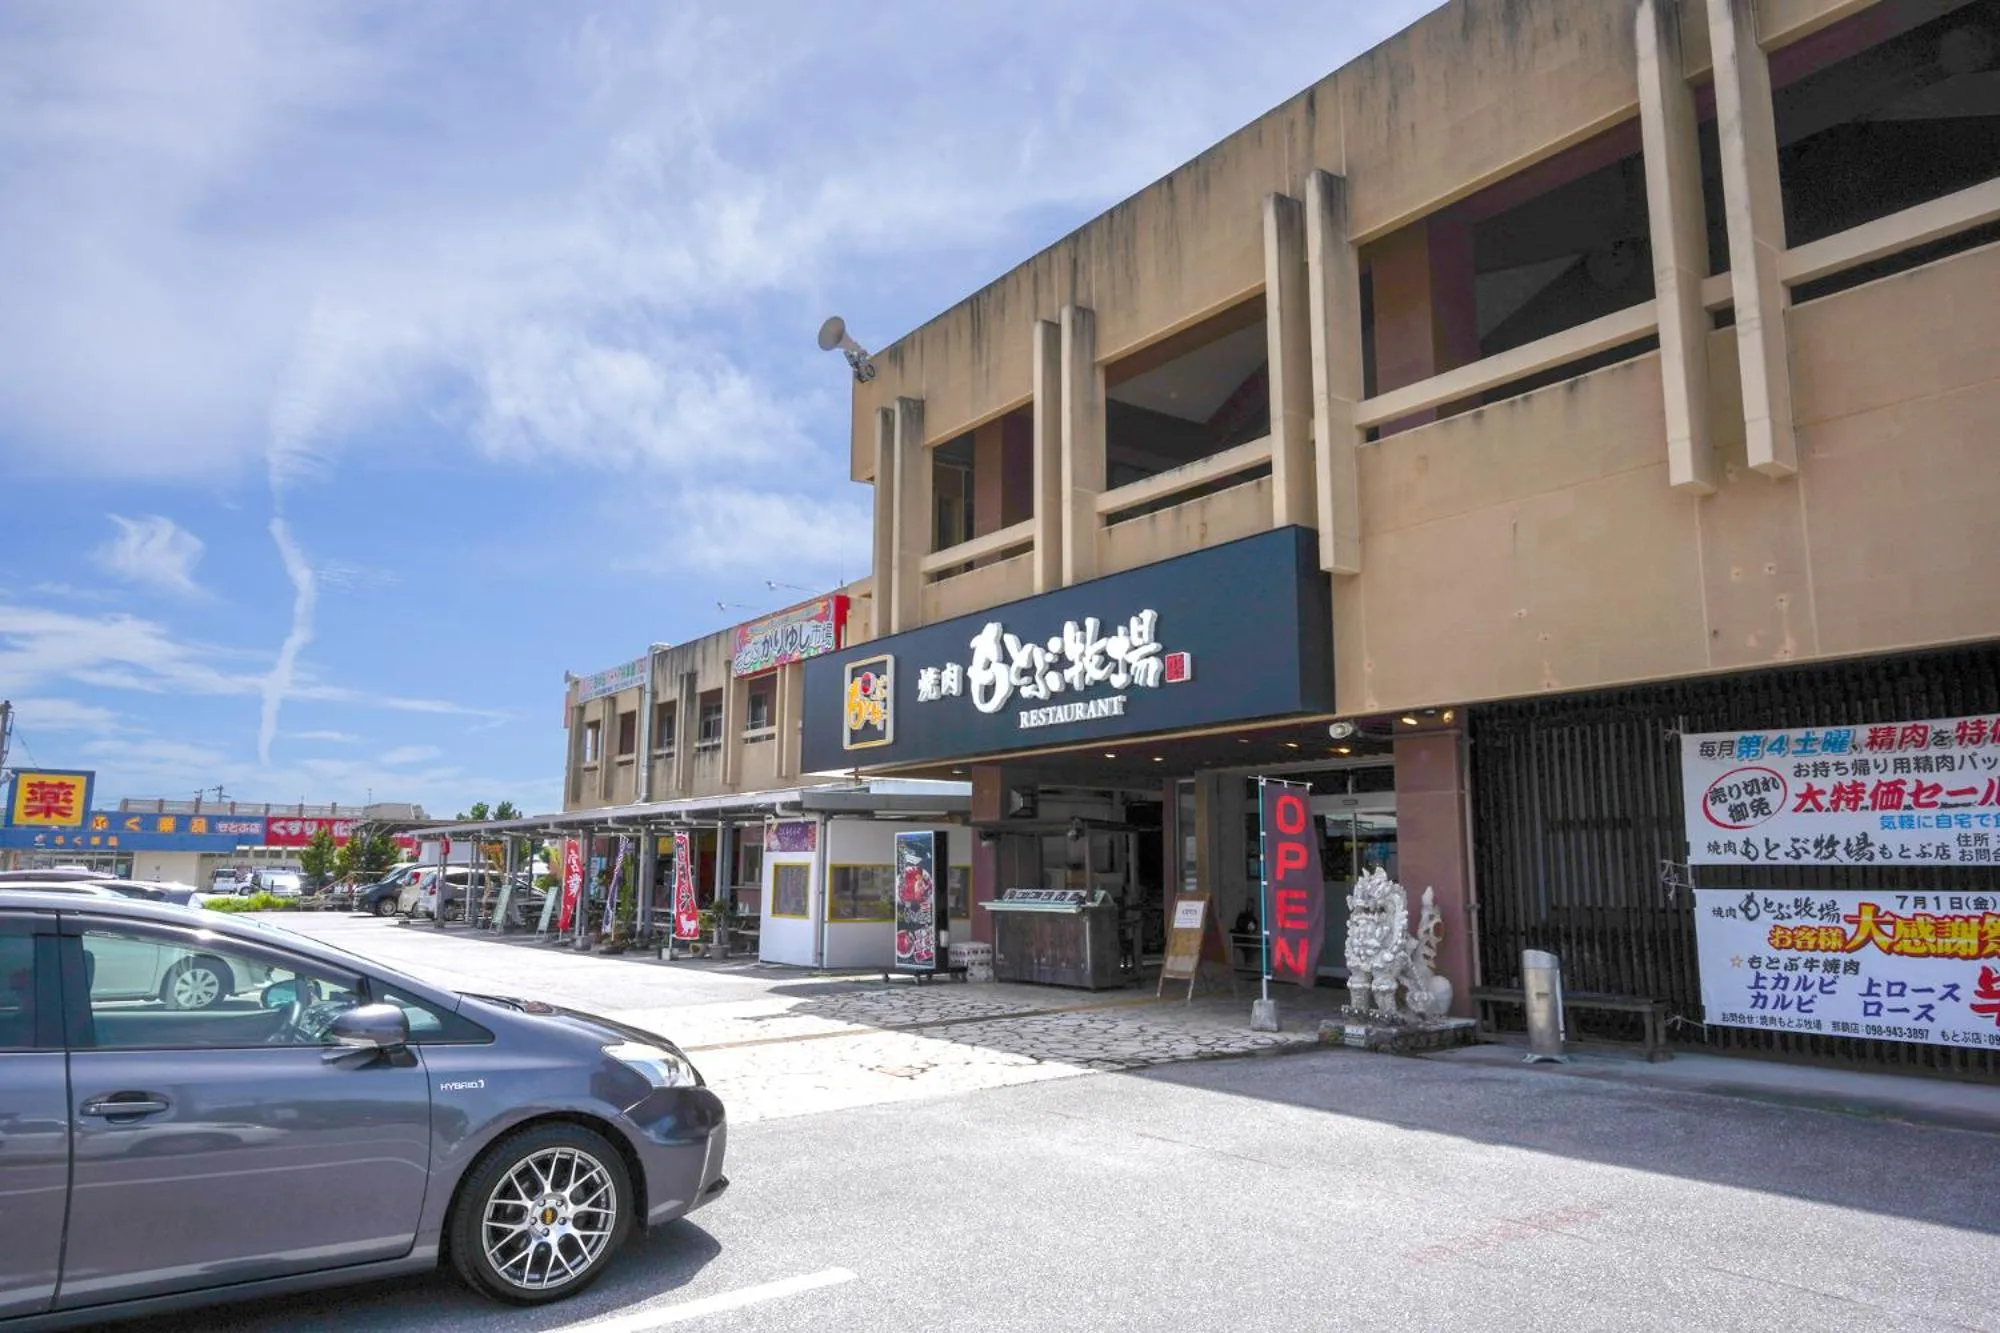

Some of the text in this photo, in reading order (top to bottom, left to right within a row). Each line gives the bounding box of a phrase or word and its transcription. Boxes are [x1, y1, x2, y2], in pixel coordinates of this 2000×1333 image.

[917, 662, 963, 702] 焼肉
[1018, 695, 1128, 729] RESTAURANT
[25, 780, 76, 819] 薬
[1709, 776, 1780, 806] 売り切れ
[1727, 797, 1772, 823] 御免
[1881, 812, 2000, 831] 気軽に自宅で
[1274, 795, 1309, 977] OPEN
[1747, 970, 1840, 996] 上カルビ
[1857, 976, 1962, 1003] 上ロース
[1749, 991, 1936, 1024] カルビ ロース
[440, 1081, 479, 1092] HYBRID
